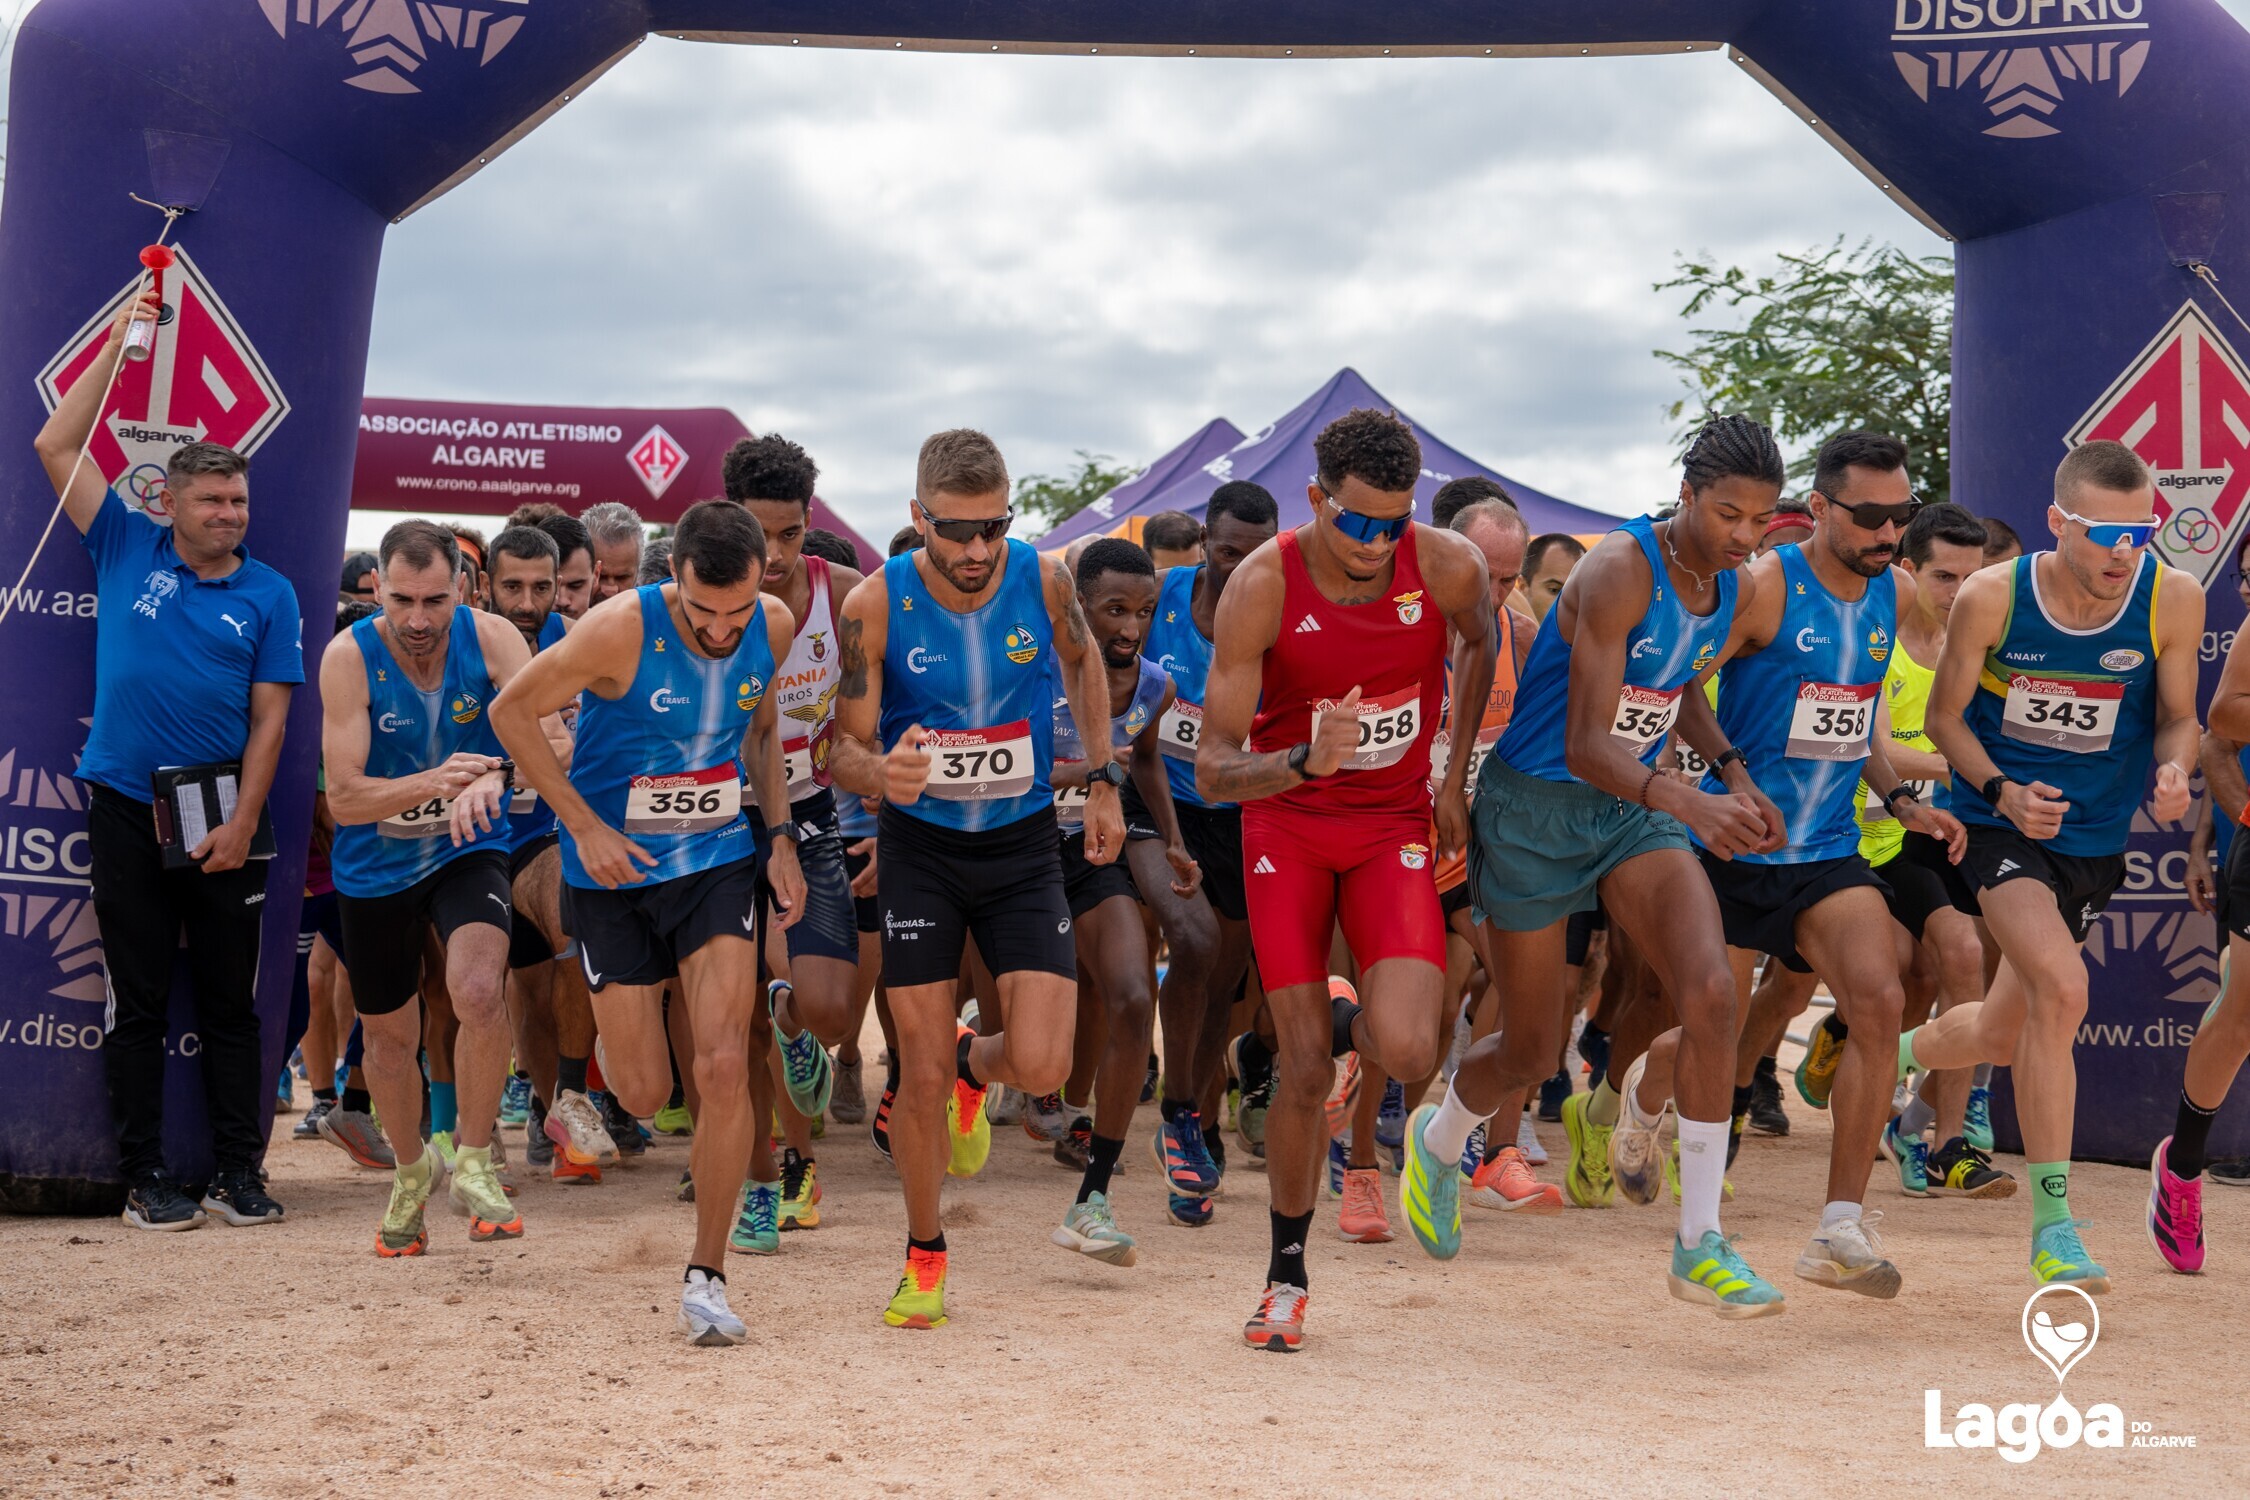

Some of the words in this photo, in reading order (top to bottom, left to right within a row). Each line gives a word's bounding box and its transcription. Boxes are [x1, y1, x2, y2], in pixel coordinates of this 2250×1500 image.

[1895, 0, 2142, 31] DISOFRIO
[118, 426, 195, 445] algarve
[359, 414, 498, 440] ASSOCIAÇÃO
[502, 423, 622, 443] ATLETISMO
[432, 445, 545, 468] ALGARVE
[396, 475, 580, 497] www.crono.aaalgarve.org
[2158, 474, 2224, 489] algarve
[132, 600, 157, 620] FPA
[1641, 645, 1662, 655] TRAVEL
[1807, 636, 1831, 644] TRAVEL
[918, 654, 948, 663] TRAVEL
[2005, 652, 2045, 662] ANAKY
[777, 666, 827, 690] TANIA
[1166, 662, 1190, 674] TRAVEL
[662, 696, 691, 704] TRAVEL
[778, 688, 813, 705] UROS
[2043, 689, 2077, 697] ALGARVE
[388, 718, 414, 726] TRAVEL
[1616, 707, 1671, 738] 352
[1812, 707, 1865, 737] 358
[2025, 698, 2099, 731] 343
[955, 738, 987, 746] ALGARVE
[1176, 720, 1201, 743] 8
[943, 748, 1014, 779] 370
[401, 797, 454, 822] 84
[649, 789, 720, 814] 356
[0, 826, 92, 875] ISO
